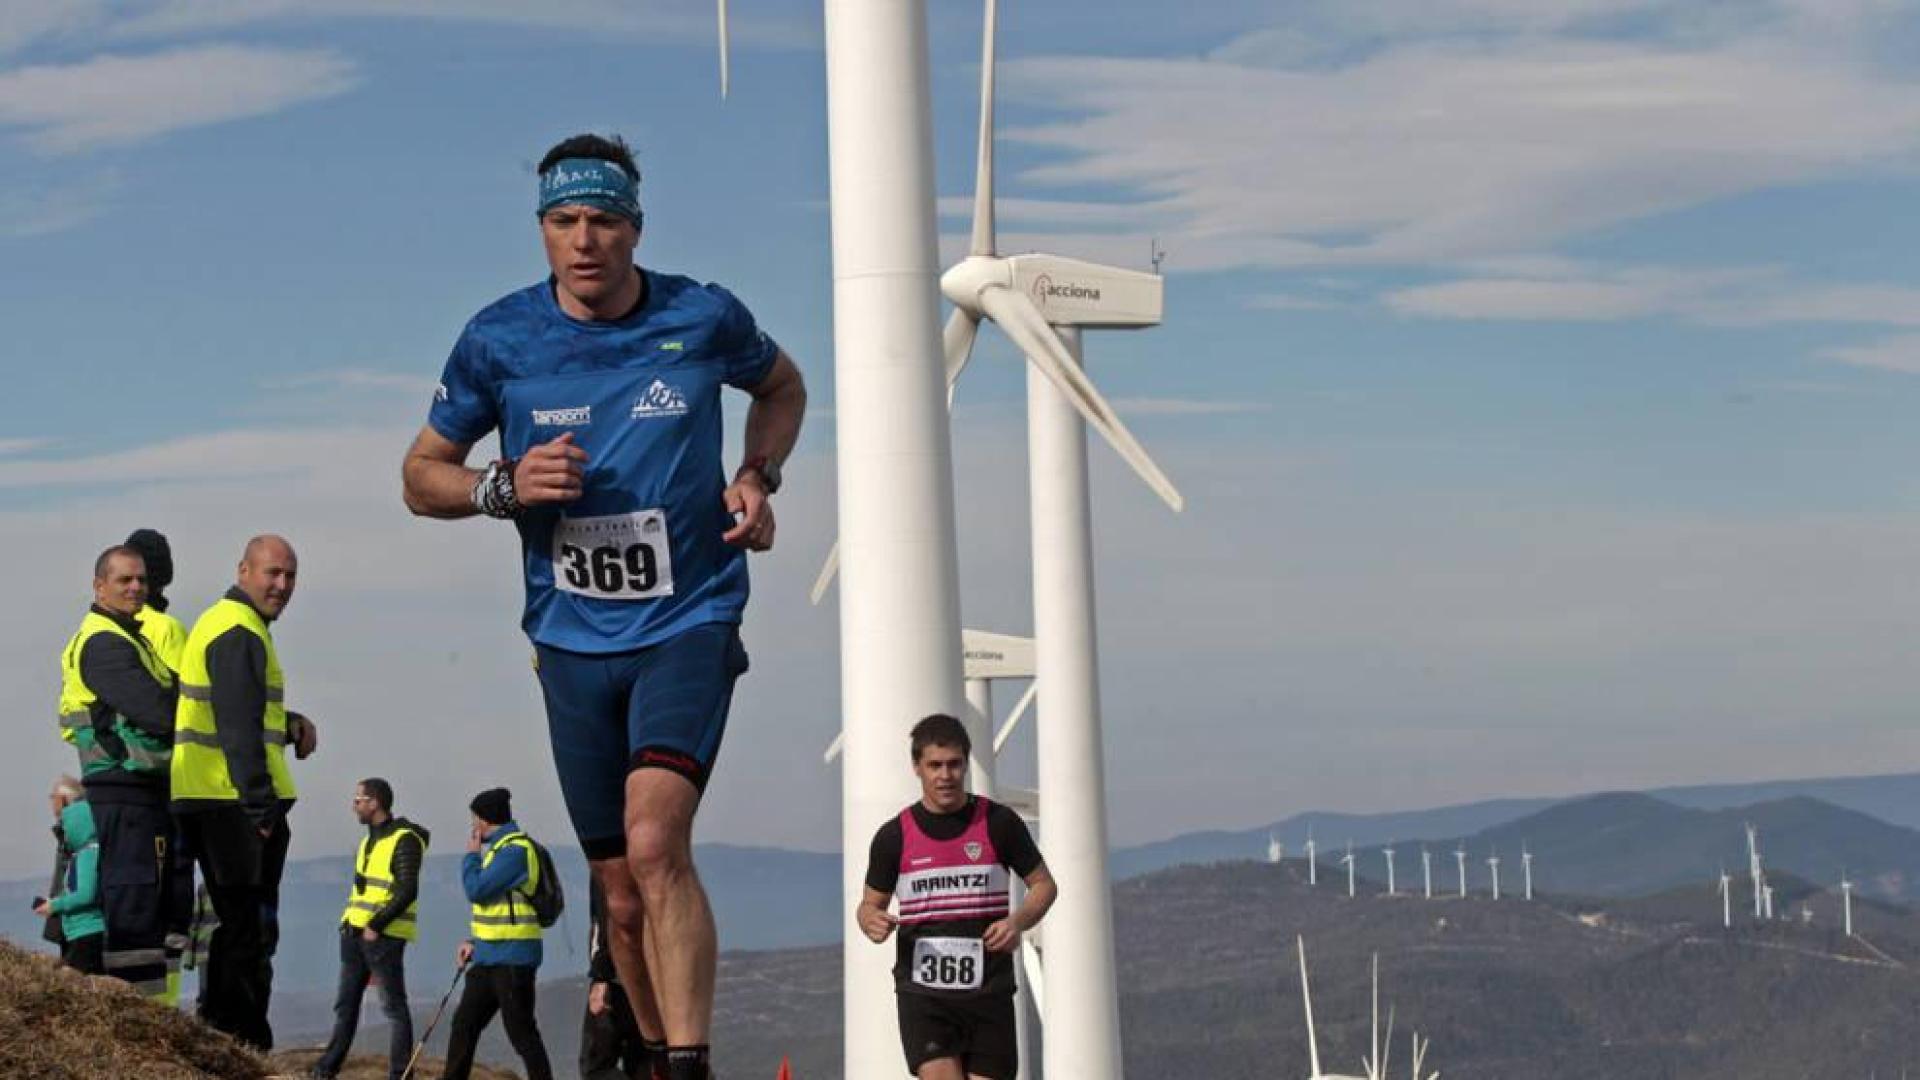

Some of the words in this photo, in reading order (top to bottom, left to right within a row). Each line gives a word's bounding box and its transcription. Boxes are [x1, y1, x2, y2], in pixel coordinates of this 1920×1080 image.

[1047, 283, 1100, 301] acciona
[561, 543, 658, 592] 369
[911, 873, 990, 893] IRRINTZI
[920, 954, 975, 984] 368
